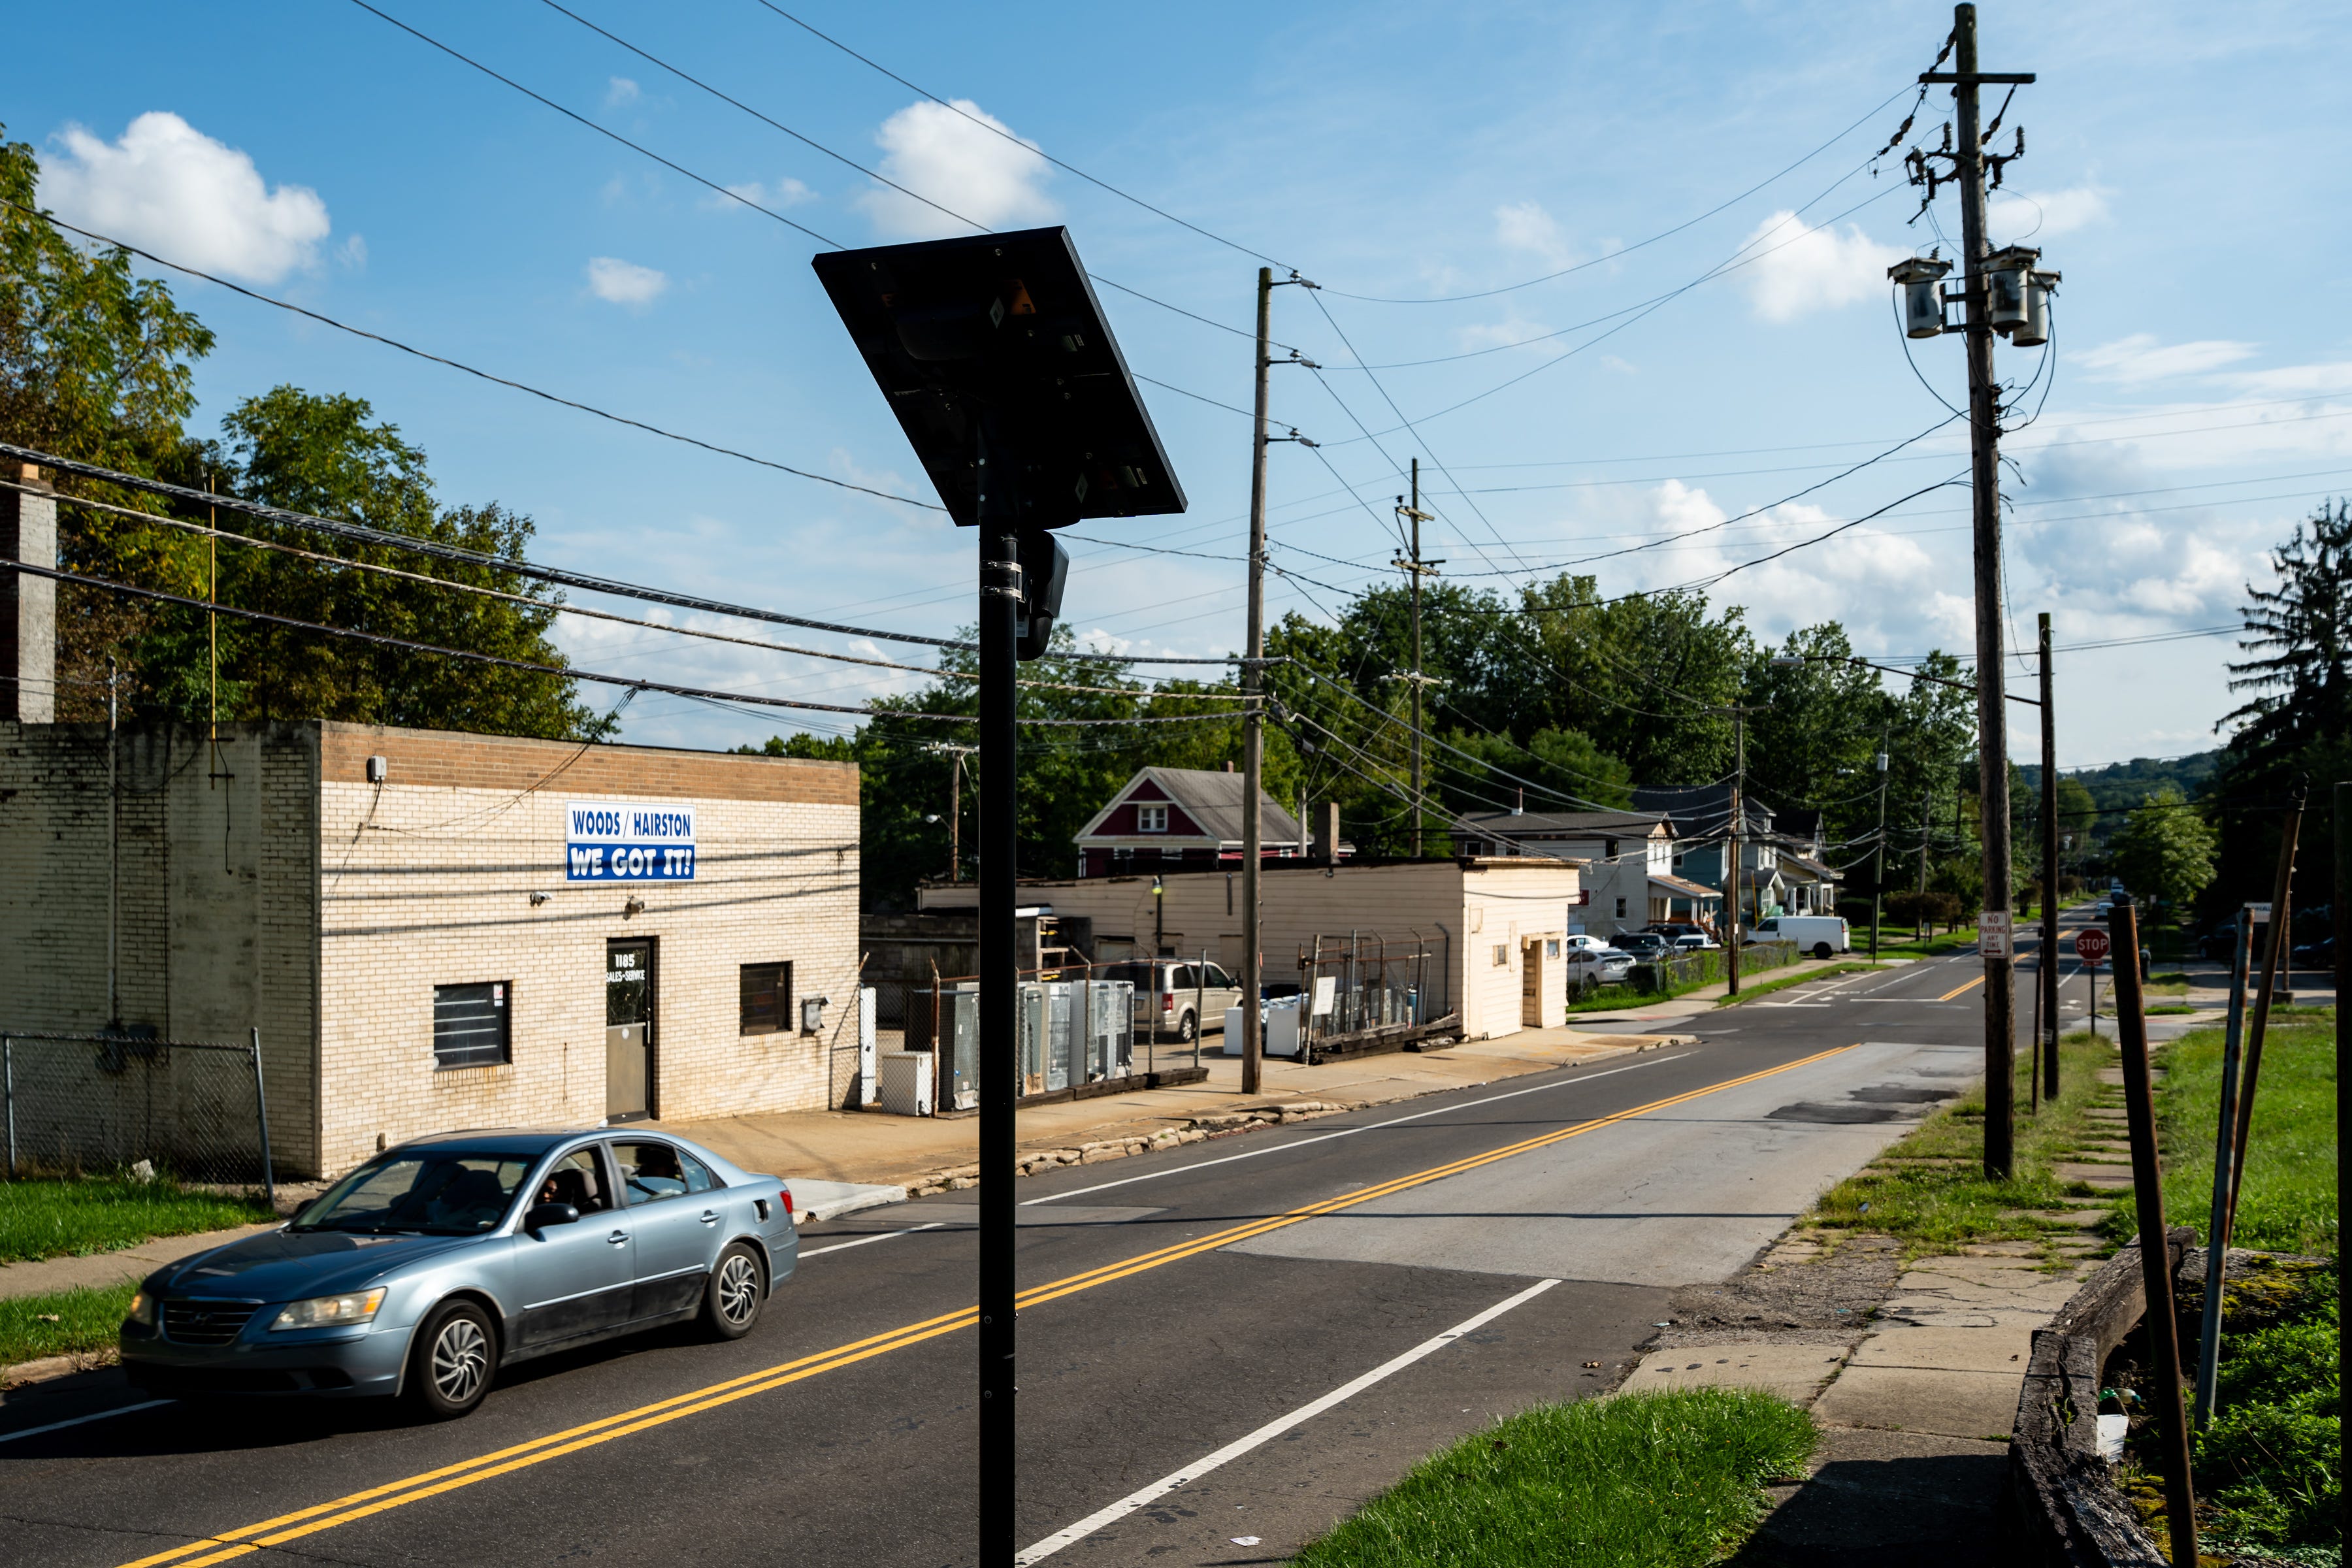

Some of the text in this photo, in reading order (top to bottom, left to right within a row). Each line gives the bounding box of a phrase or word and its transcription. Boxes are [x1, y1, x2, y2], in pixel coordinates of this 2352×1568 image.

[572, 810, 691, 838] WOODS / HAIRSTON
[570, 847, 693, 877] WE GOT IT!
[1987, 915, 1999, 924] NO
[1980, 925, 2006, 934] PARKING
[2078, 938, 2108, 951] STOP
[614, 954, 635, 968] 1185
